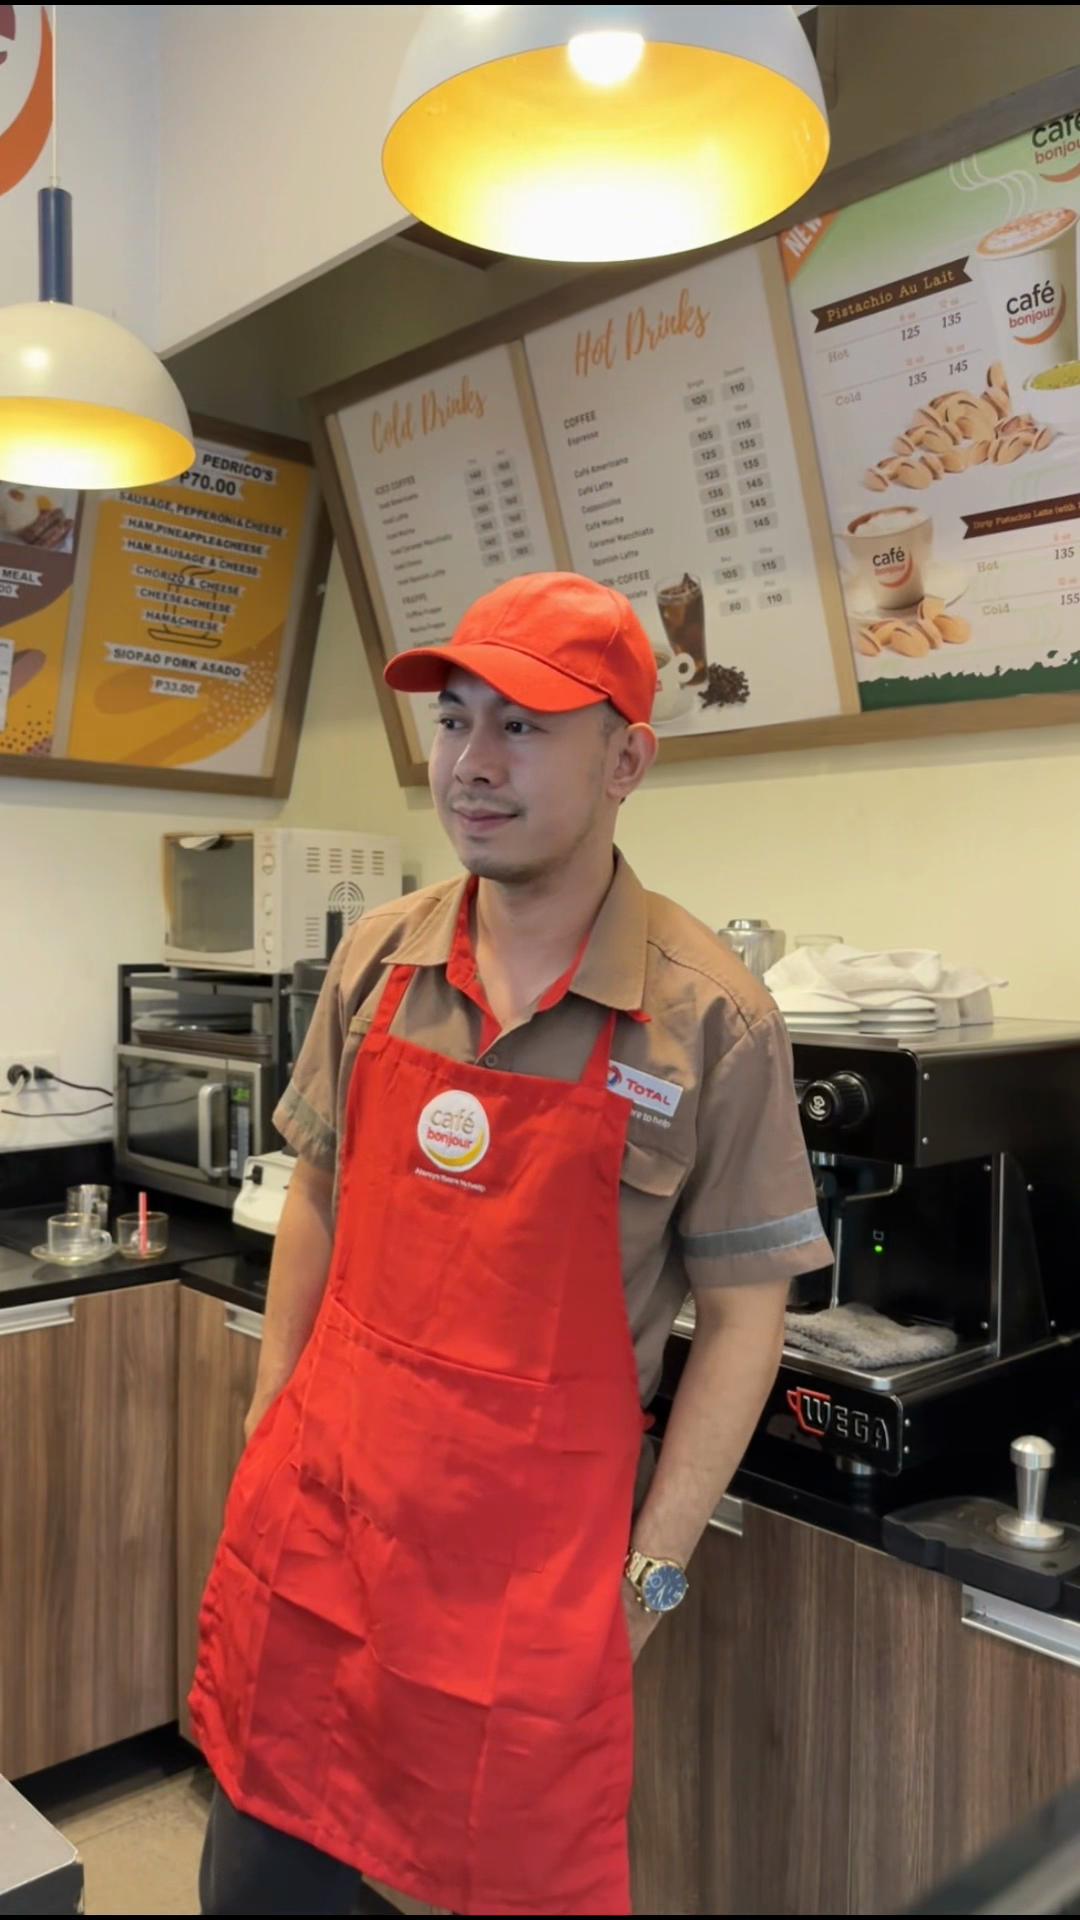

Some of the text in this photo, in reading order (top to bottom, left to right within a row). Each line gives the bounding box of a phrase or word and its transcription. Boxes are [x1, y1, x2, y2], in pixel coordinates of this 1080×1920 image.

[827, 270, 955, 322] Pistachio Au Lait
[1006, 280, 1055, 316] café
[1008, 306, 1056, 329] bonjour
[574, 287, 711, 377] Hot Drinks
[828, 312, 961, 363] Hot 125 135
[730, 382, 745, 395] 110
[835, 360, 968, 407] Cold 135 145
[372, 375, 486, 454] Cold Drinks
[563, 410, 596, 429] COFFEE
[698, 430, 713, 441] 105
[736, 418, 752, 430] 115
[203, 453, 275, 482] PEDRICO'S
[746, 478, 763, 489] 145
[750, 497, 767, 508] 145
[753, 516, 770, 528] 145
[219, 559, 259, 576] CHEESE
[761, 560, 777, 571] 115
[872, 546, 905, 567] café
[976, 546, 1075, 573] Hot 135
[2, 568, 35, 583] MEAL
[200, 580, 240, 596] CHEESE
[767, 593, 782, 605] 110
[982, 592, 1080, 616] Cold 155
[113, 648, 241, 677] SIOPAO PORK ASADO
[626, 1077, 671, 1106] TOTAL
[430, 1108, 475, 1135] café
[427, 1126, 473, 1149] bonjour
[803, 1395, 890, 1451] WEGA
